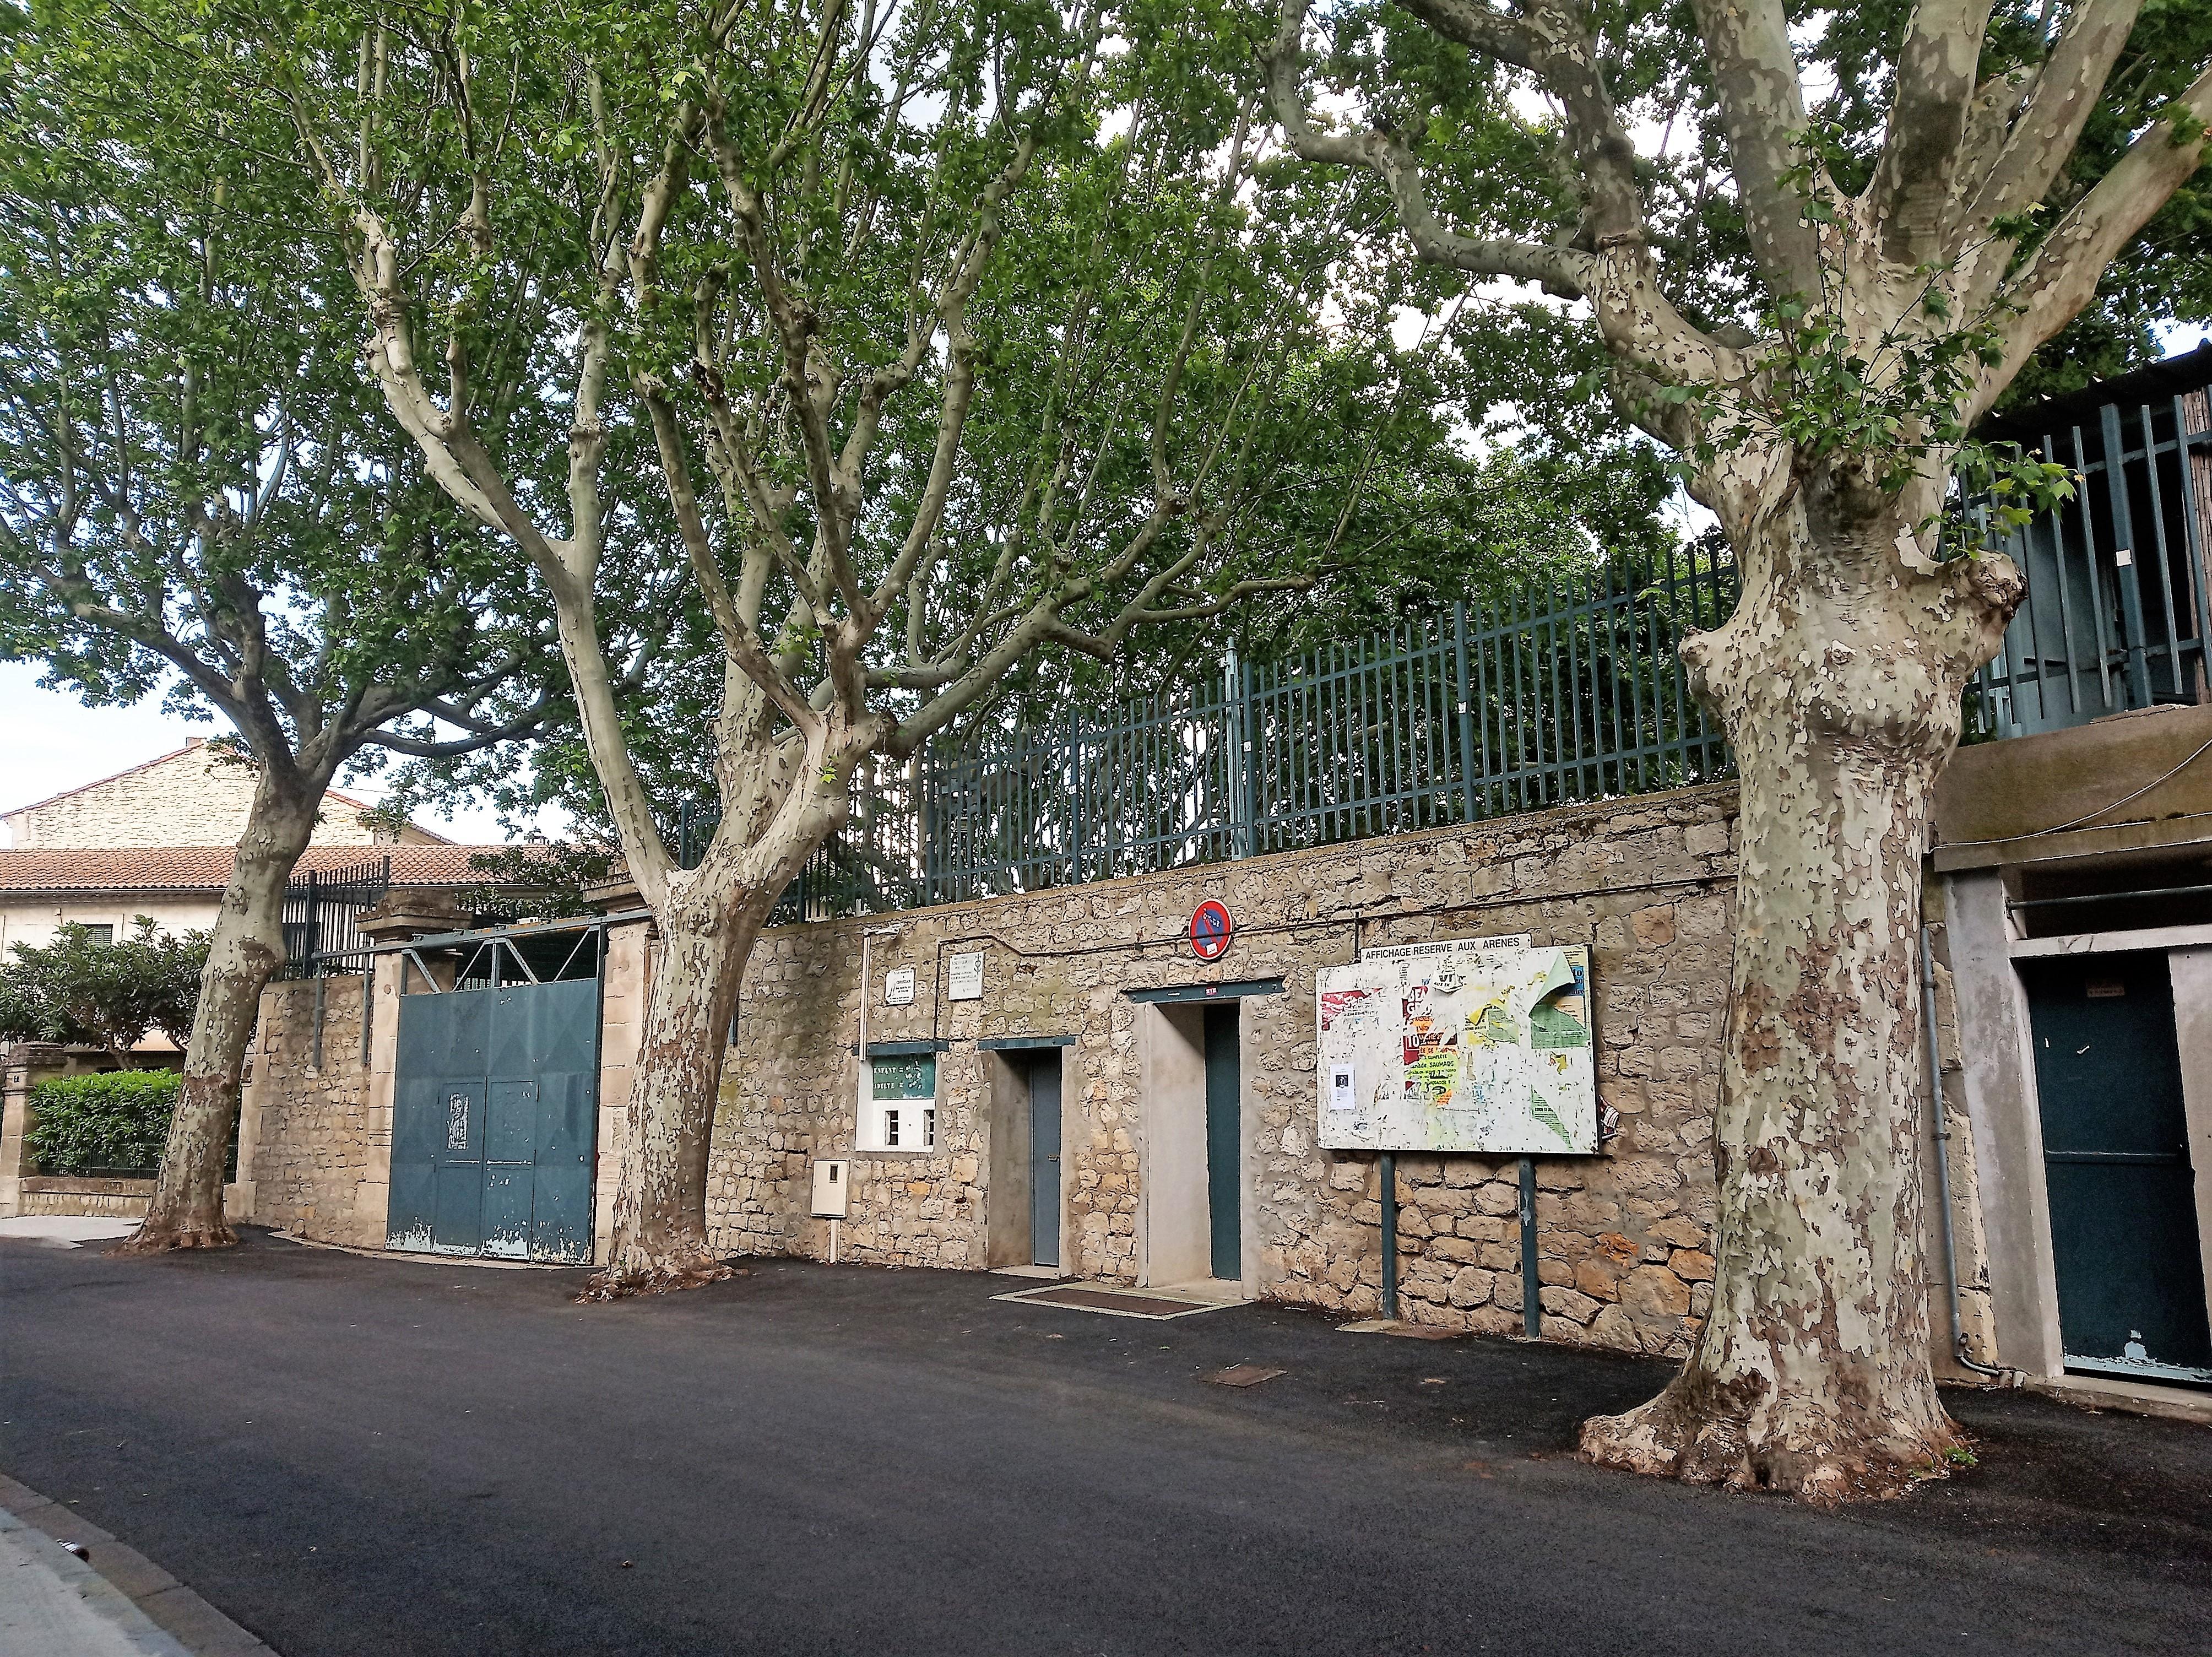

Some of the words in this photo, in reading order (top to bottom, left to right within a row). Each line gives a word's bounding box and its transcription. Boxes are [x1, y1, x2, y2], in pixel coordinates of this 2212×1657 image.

[1365, 947, 1411, 960] AFFICHAGE
[1413, 943, 1452, 955] RESERVE
[1457, 941, 1476, 951] AUX
[1483, 937, 1520, 949] ARENES
[874, 1066, 897, 1075] ENFANT
